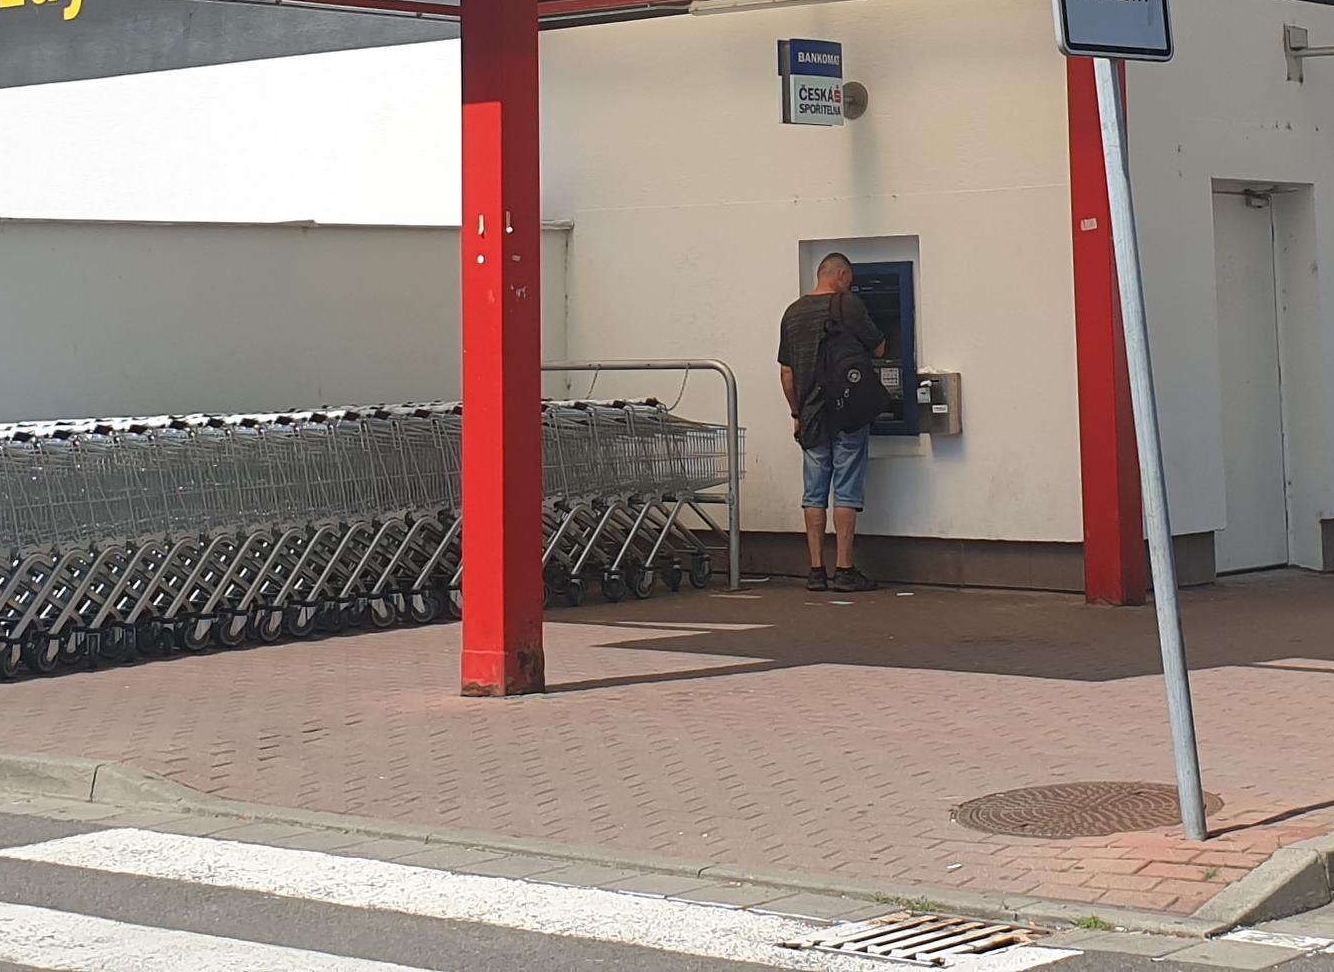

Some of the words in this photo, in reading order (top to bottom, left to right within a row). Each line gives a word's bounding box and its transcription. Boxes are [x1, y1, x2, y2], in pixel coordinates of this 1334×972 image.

[798, 52, 840, 66] BANKOMAT
[799, 84, 834, 103] ČESKÁ
[799, 103, 841, 116] SPOŘITELNA
